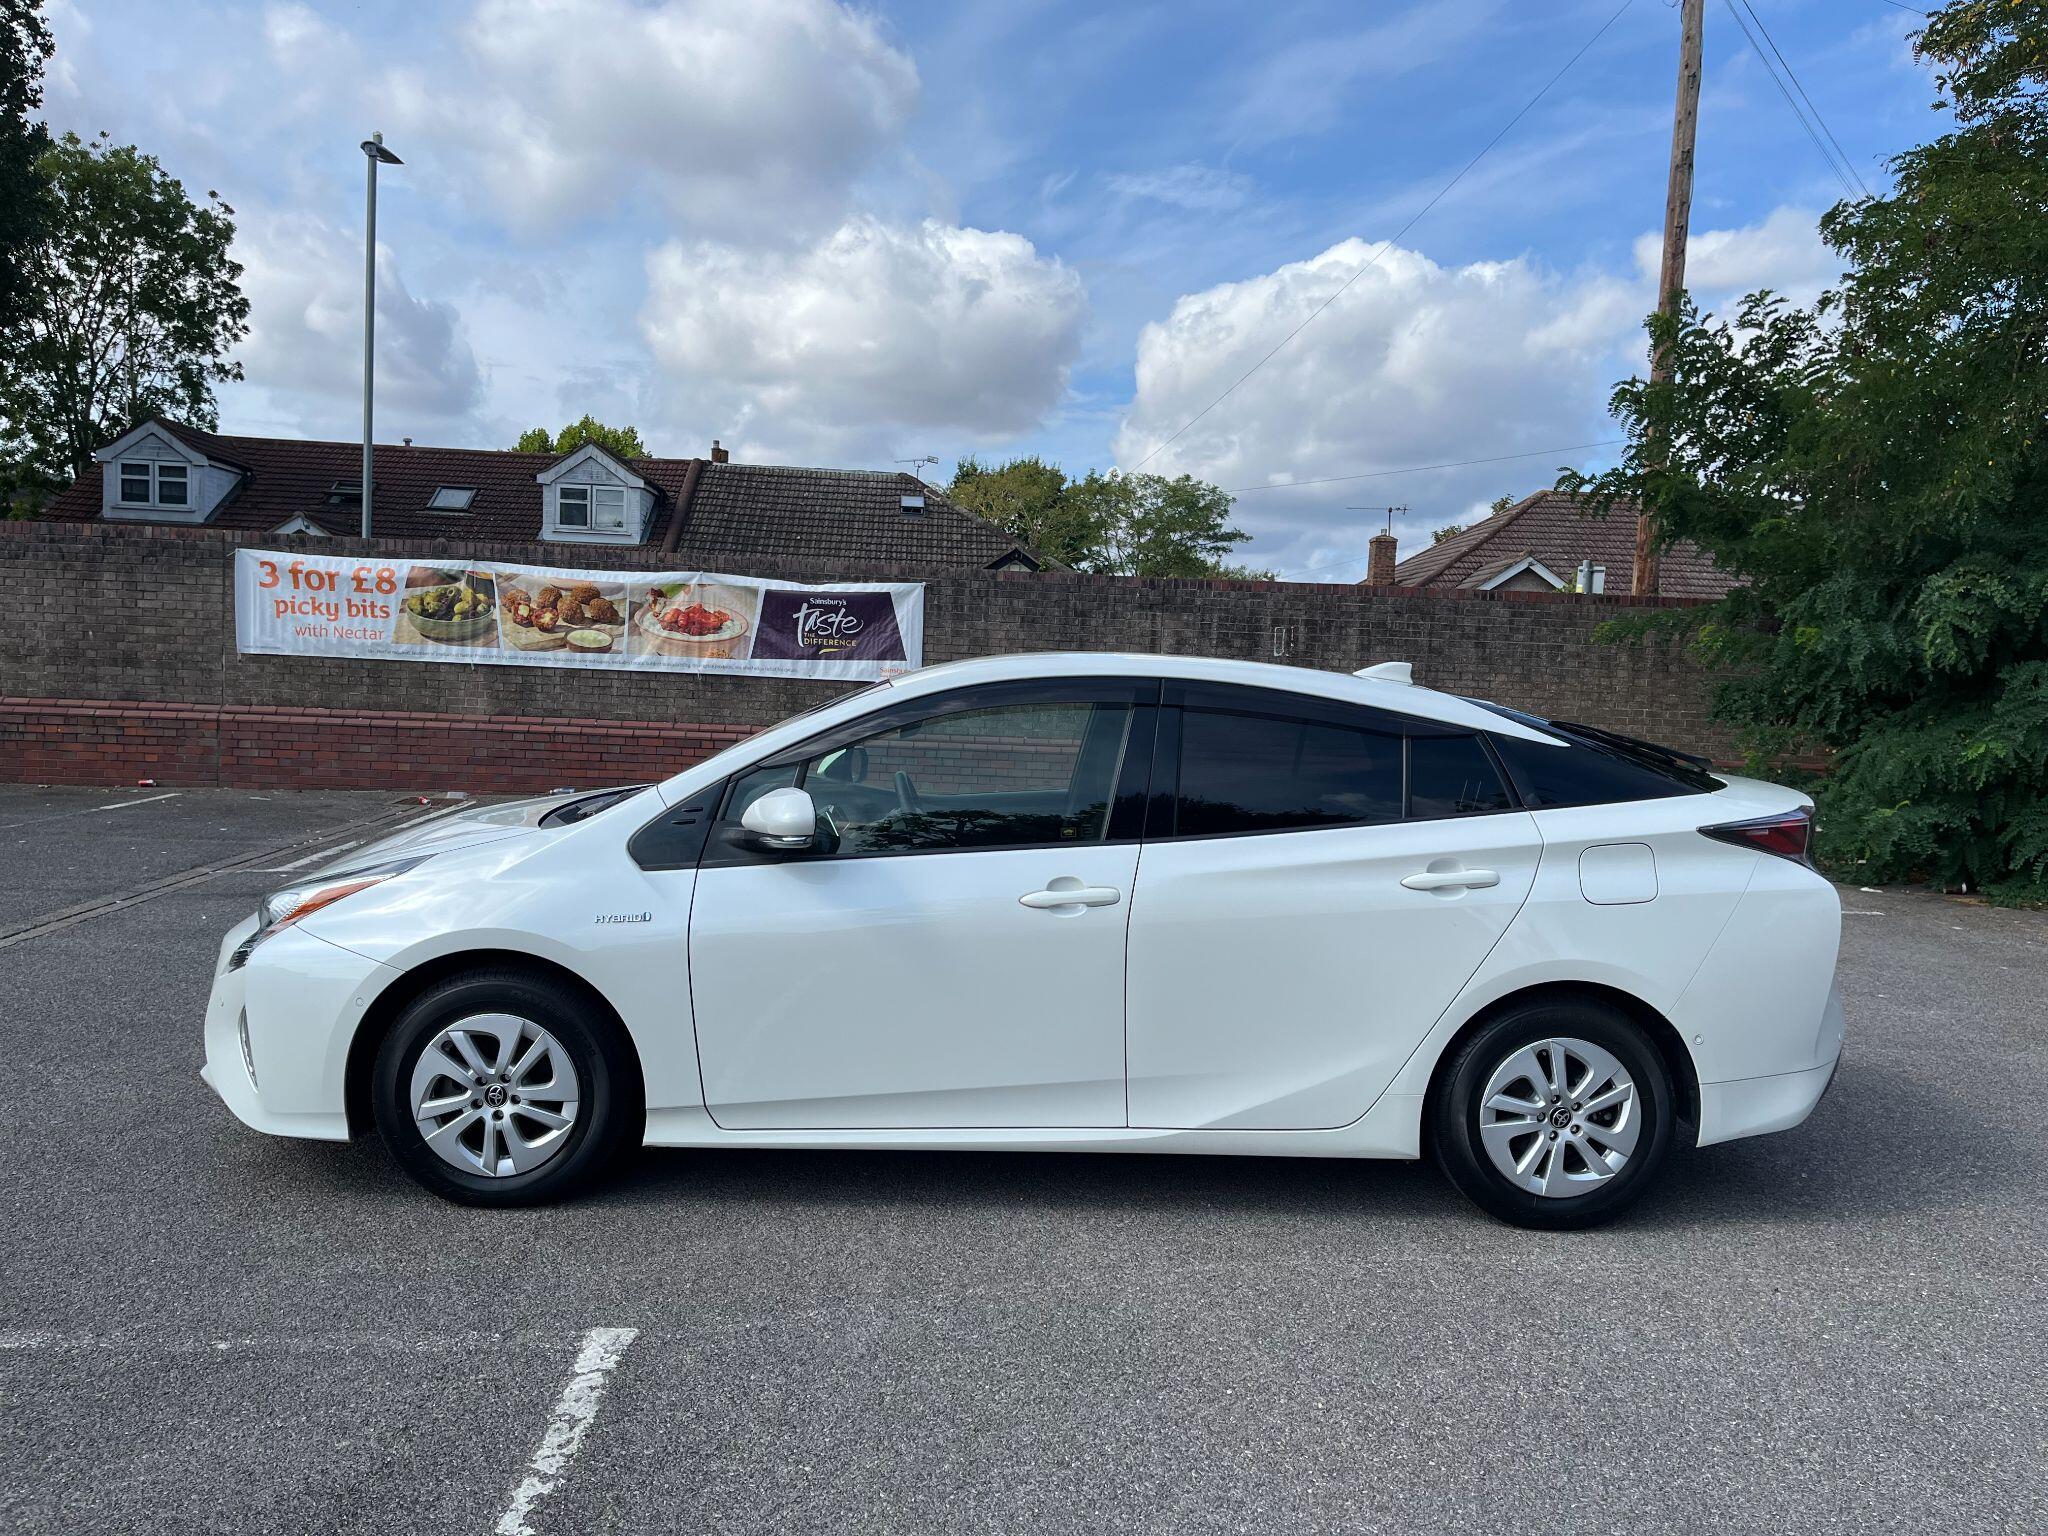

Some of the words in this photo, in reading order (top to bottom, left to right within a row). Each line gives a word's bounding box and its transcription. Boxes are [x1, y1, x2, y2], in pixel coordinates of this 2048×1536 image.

[259, 560, 280, 588] 3
[288, 560, 340, 592] for
[351, 566, 397, 595] £8
[809, 597, 847, 606] Sainsbury's
[274, 595, 339, 622] picky
[346, 598, 391, 619] bits
[294, 623, 329, 638] with
[333, 626, 385, 640] Nectar
[804, 638, 857, 647] DIFFERENCE
[594, 914, 643, 924] HYBRID
